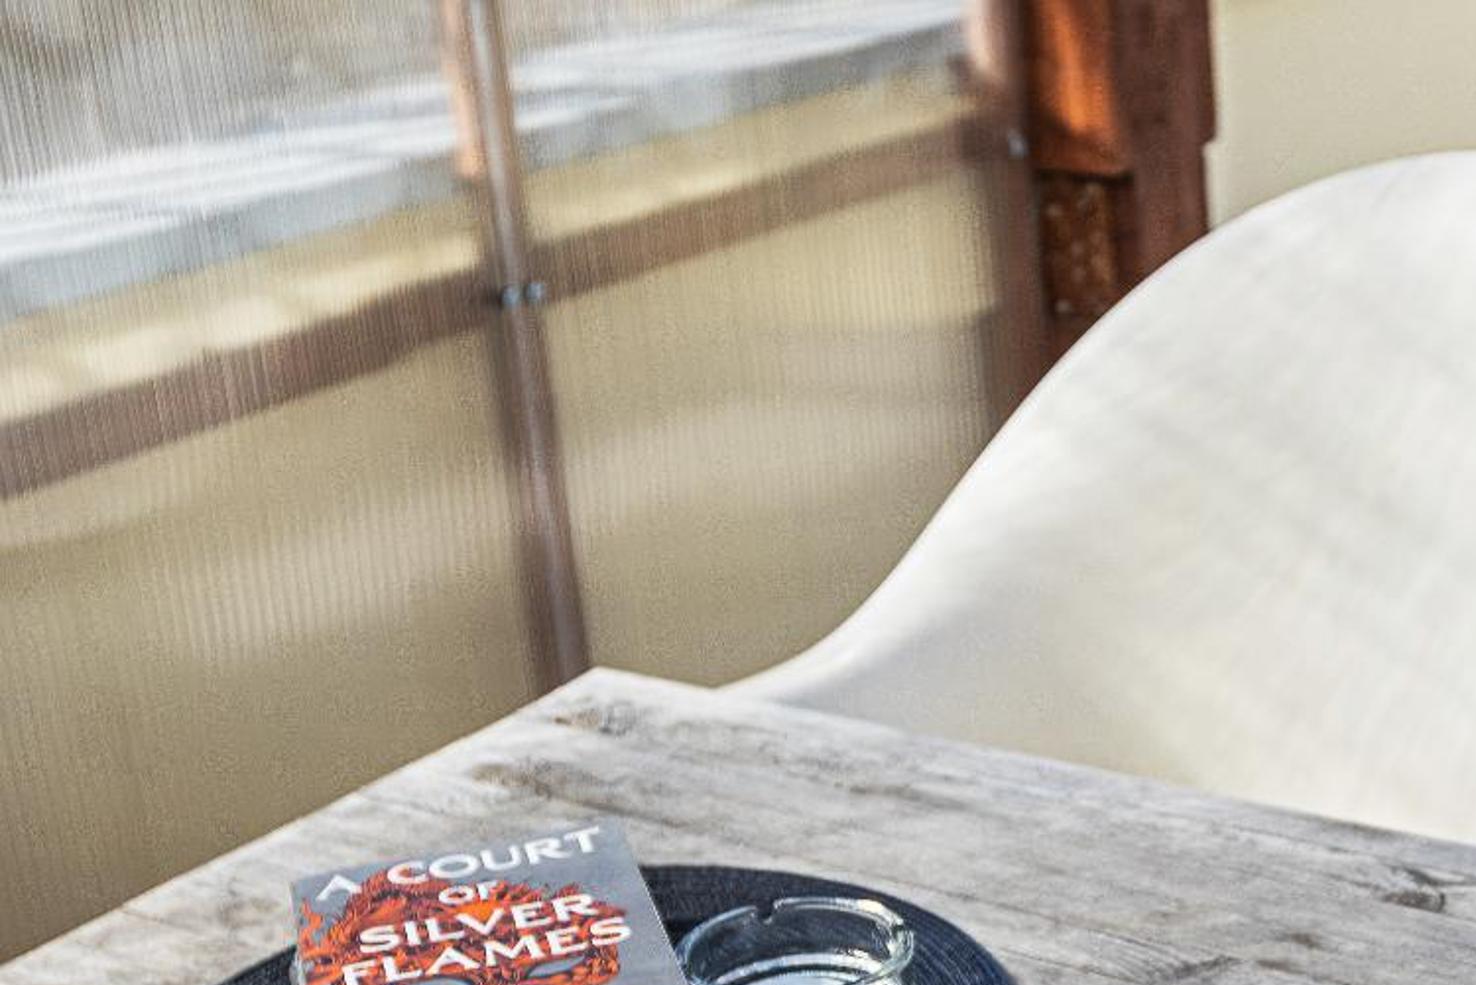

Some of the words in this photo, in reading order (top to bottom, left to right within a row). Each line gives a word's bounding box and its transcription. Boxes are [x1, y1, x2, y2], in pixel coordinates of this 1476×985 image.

[316, 873, 362, 901] A
[387, 826, 600, 885] COURT
[438, 879, 499, 906] OF
[358, 893, 600, 954] SILVER
